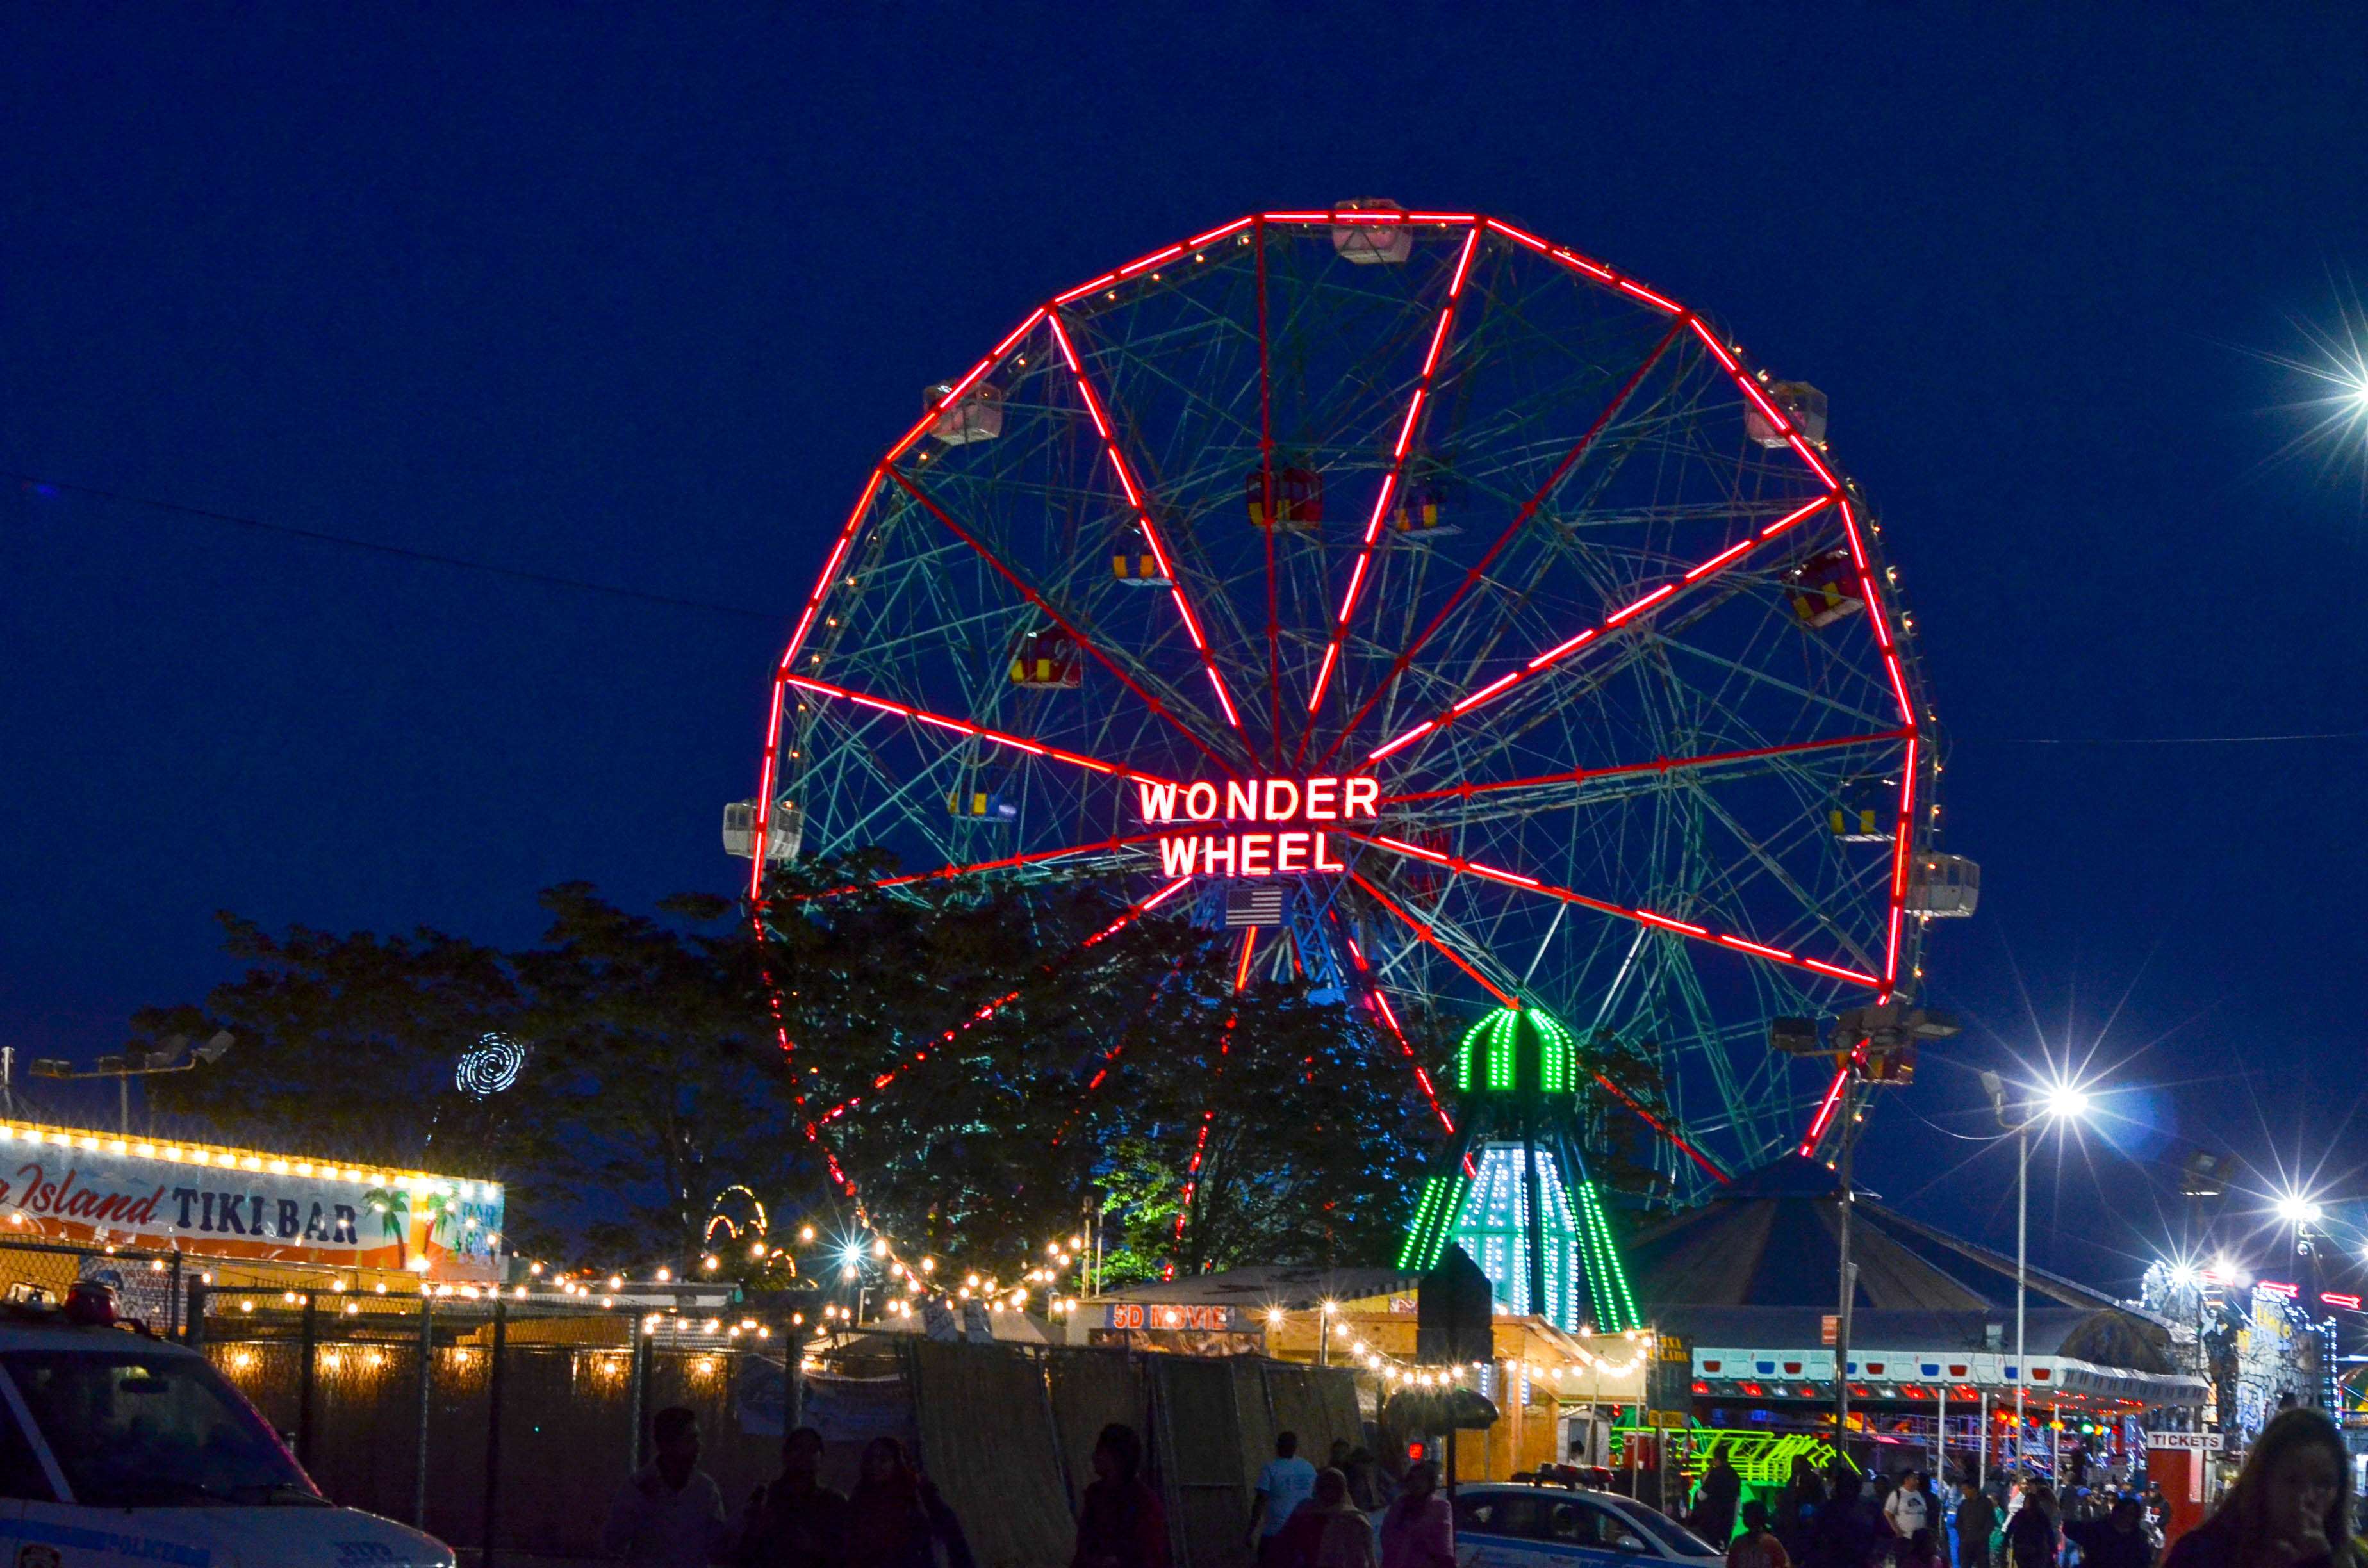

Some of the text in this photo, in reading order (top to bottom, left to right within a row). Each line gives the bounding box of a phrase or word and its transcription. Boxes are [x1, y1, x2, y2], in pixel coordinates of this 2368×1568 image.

[1140, 776, 1380, 824] WONDER
[1160, 831, 1345, 877] WHEEL
[16, 1162, 166, 1225] Island
[172, 1186, 265, 1236] TIKI
[277, 1198, 358, 1245] BAR
[1114, 1303, 1228, 1330] 5D MOVIE
[2152, 1434, 2219, 1447] TICKETS
